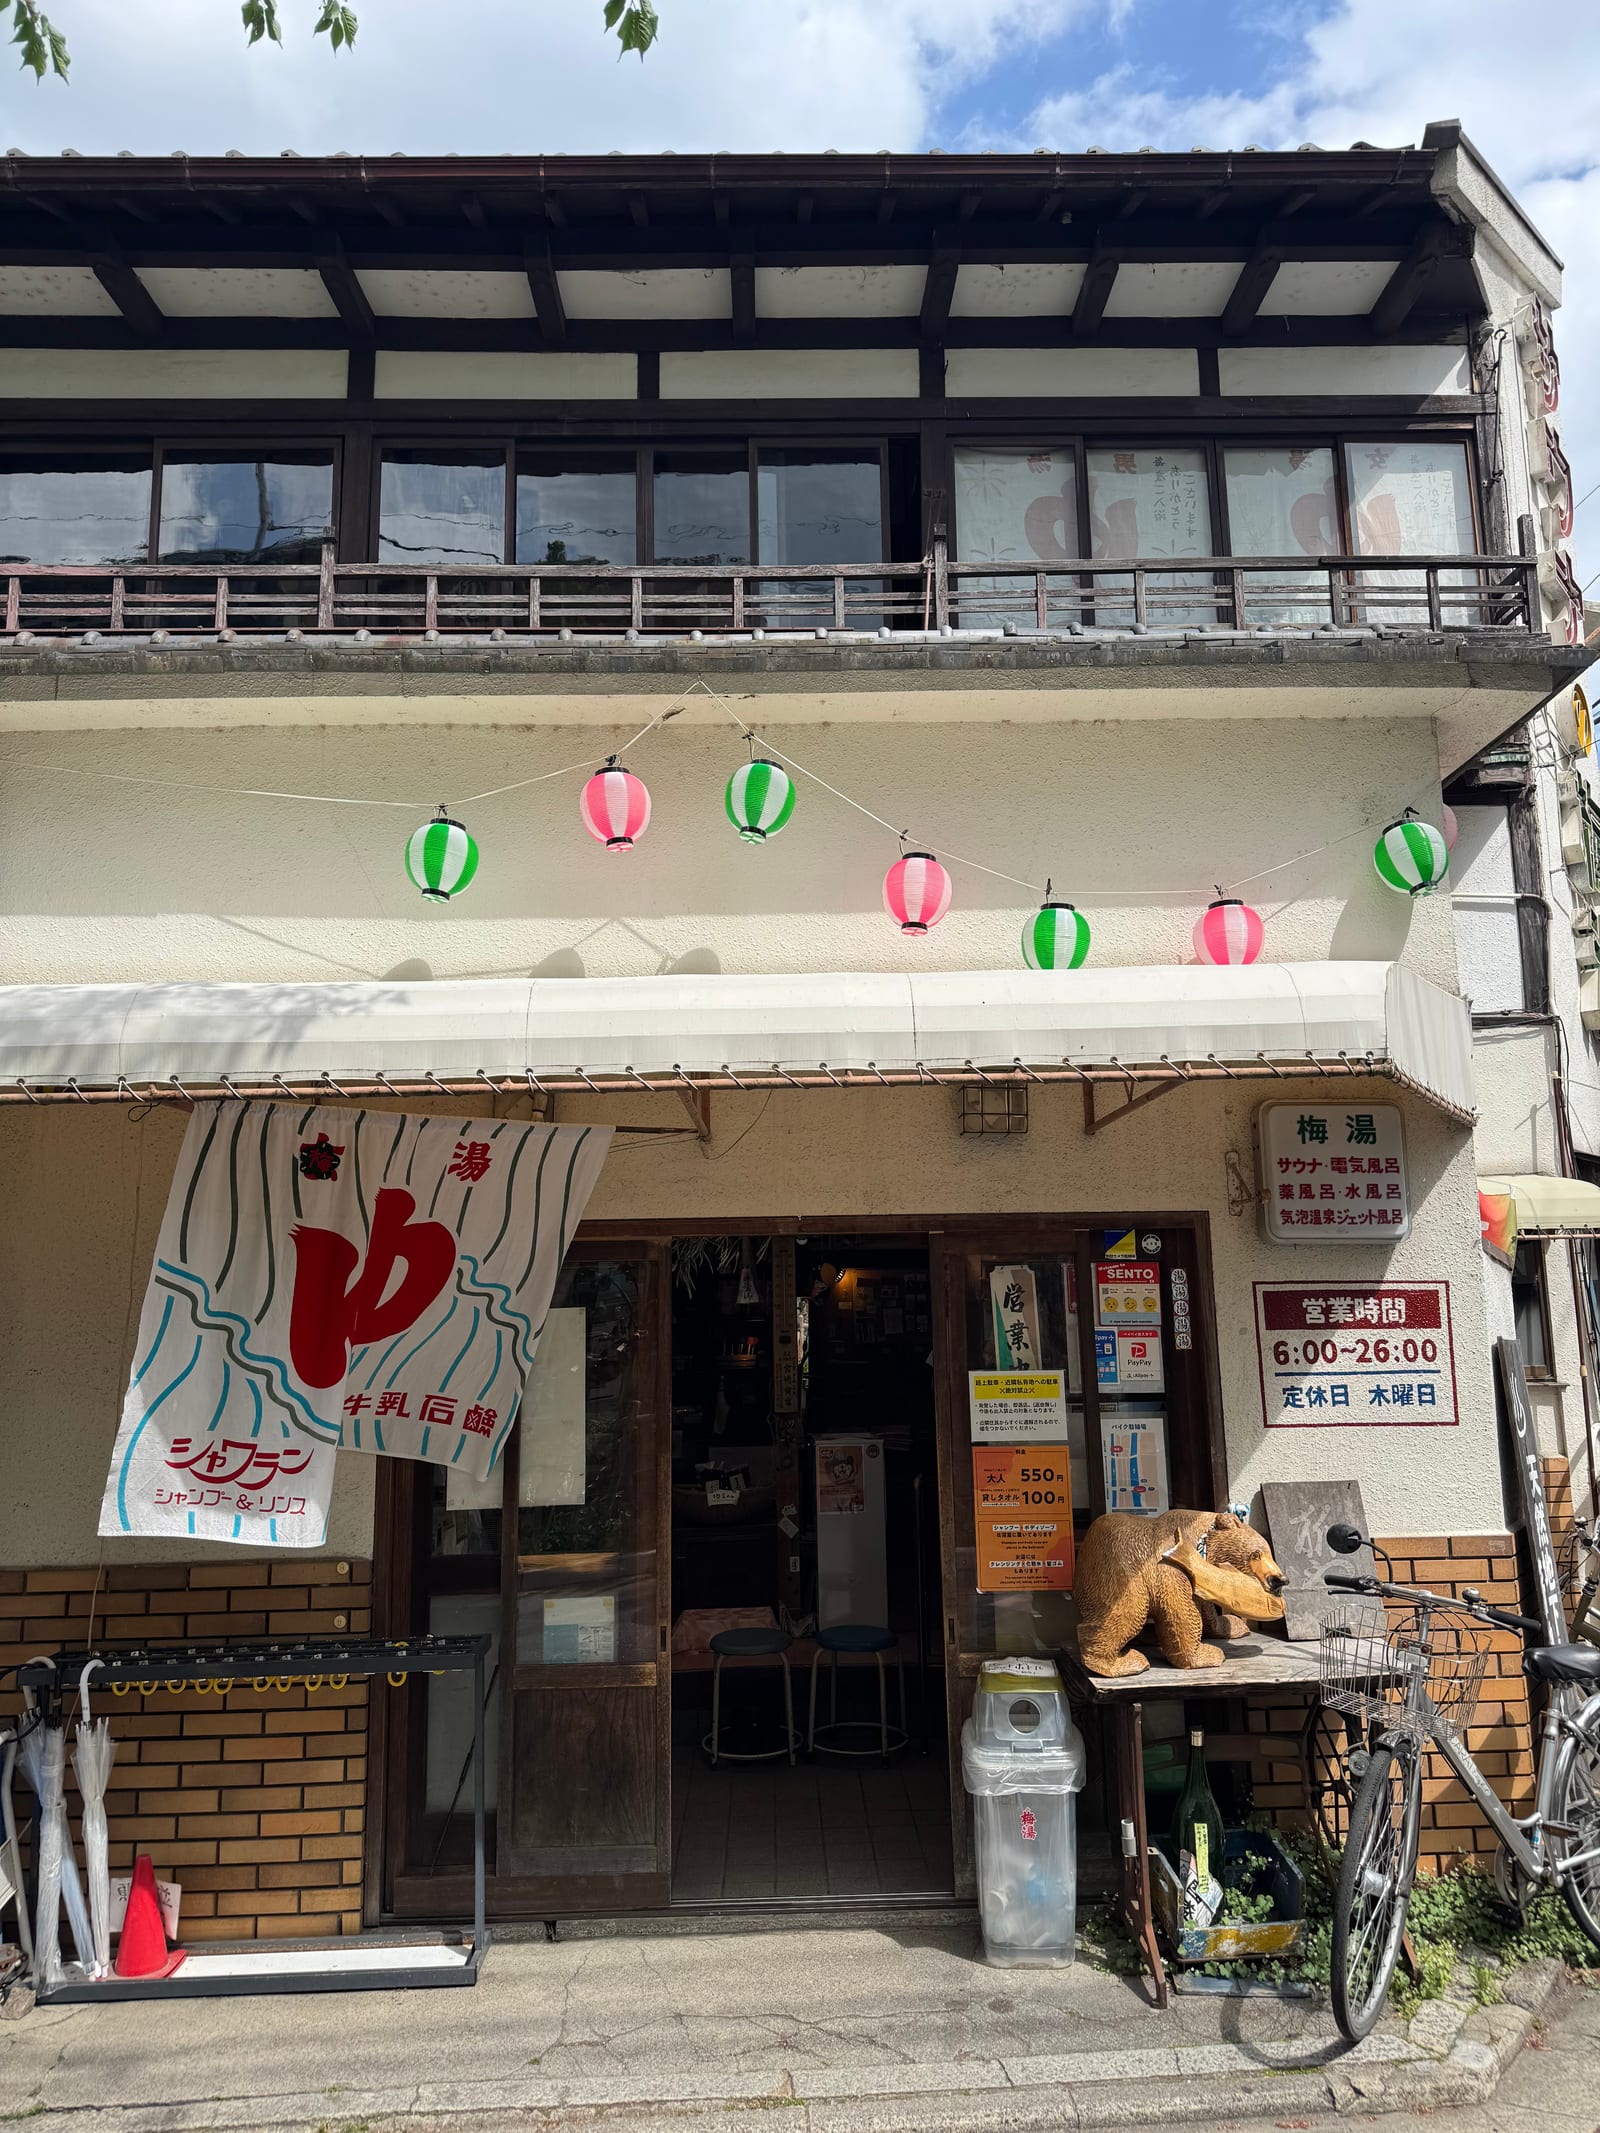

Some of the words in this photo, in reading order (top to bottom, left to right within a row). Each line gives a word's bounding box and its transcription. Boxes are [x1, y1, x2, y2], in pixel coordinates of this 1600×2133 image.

[1297, 1113, 1377, 1145] 梅湯
[448, 1139, 493, 1183] 湯
[1277, 1156, 1400, 1175] サウナ・電気風呂
[1278, 1183, 1402, 1200] 薬風呂・水風呂
[1280, 1208, 1403, 1226] 気泡温泉ジェット風呂
[1107, 1268, 1154, 1280] SENTO
[288, 1186, 456, 1389] ゆ
[1302, 1297, 1406, 1325] 営業時間
[1127, 1359, 1152, 1367] PayPay
[1282, 1384, 1350, 1409] 定休日
[1368, 1383, 1437, 1408] 木曜日
[164, 1437, 315, 1490] シャワラン
[987, 1474, 1006, 1484] 大人
[982, 1493, 1020, 1502] 貸しタオル
[1020, 1810, 1037, 1839] 梅湯
